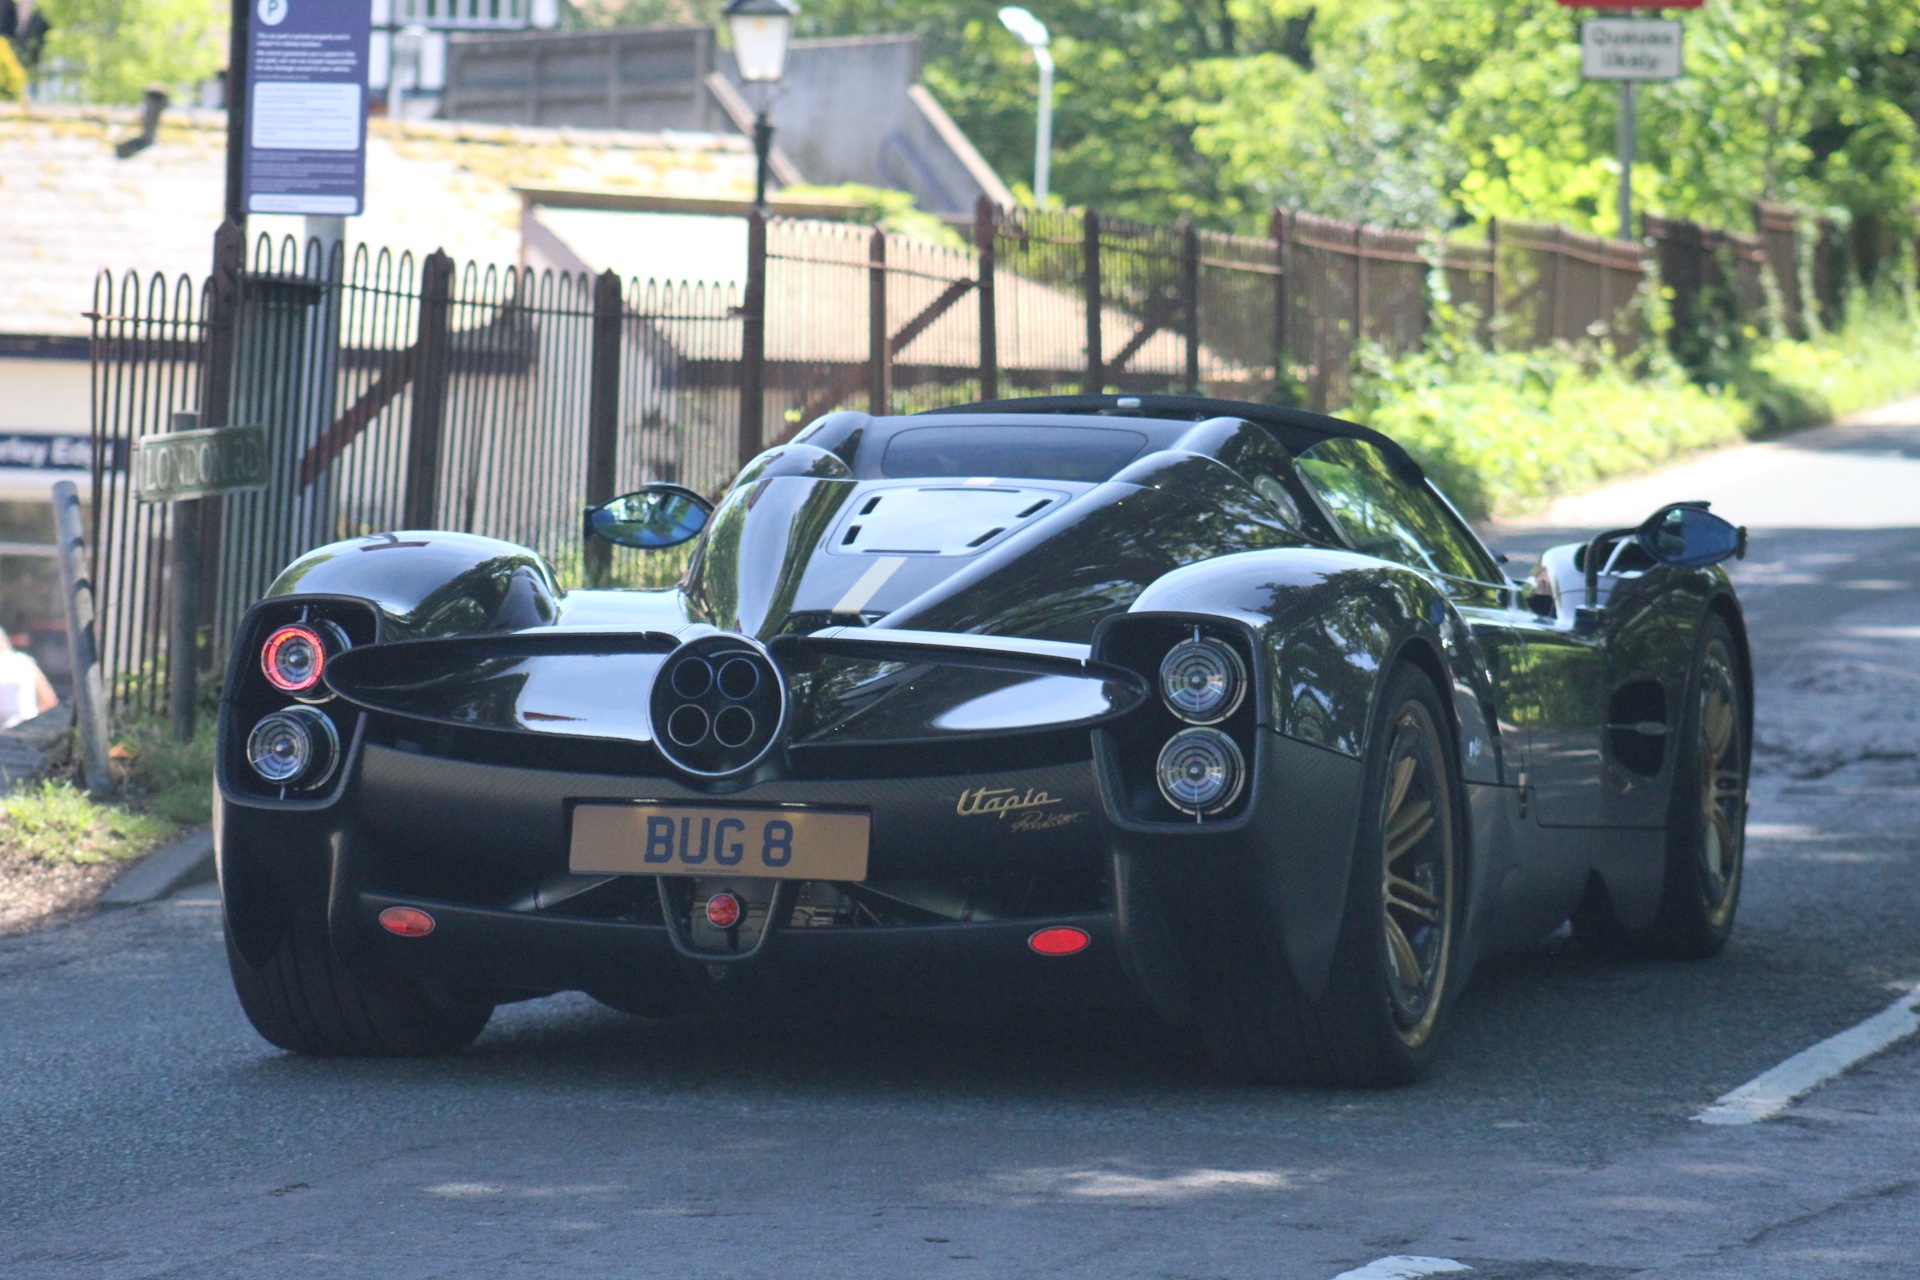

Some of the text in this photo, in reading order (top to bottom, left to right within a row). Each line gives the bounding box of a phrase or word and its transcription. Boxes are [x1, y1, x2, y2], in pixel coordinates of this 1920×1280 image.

[1591, 26, 1673, 47] Queues
[145, 441, 227, 491] LONDON
[956, 786, 1064, 820] Utopia
[643, 815, 795, 868] BUG 8
